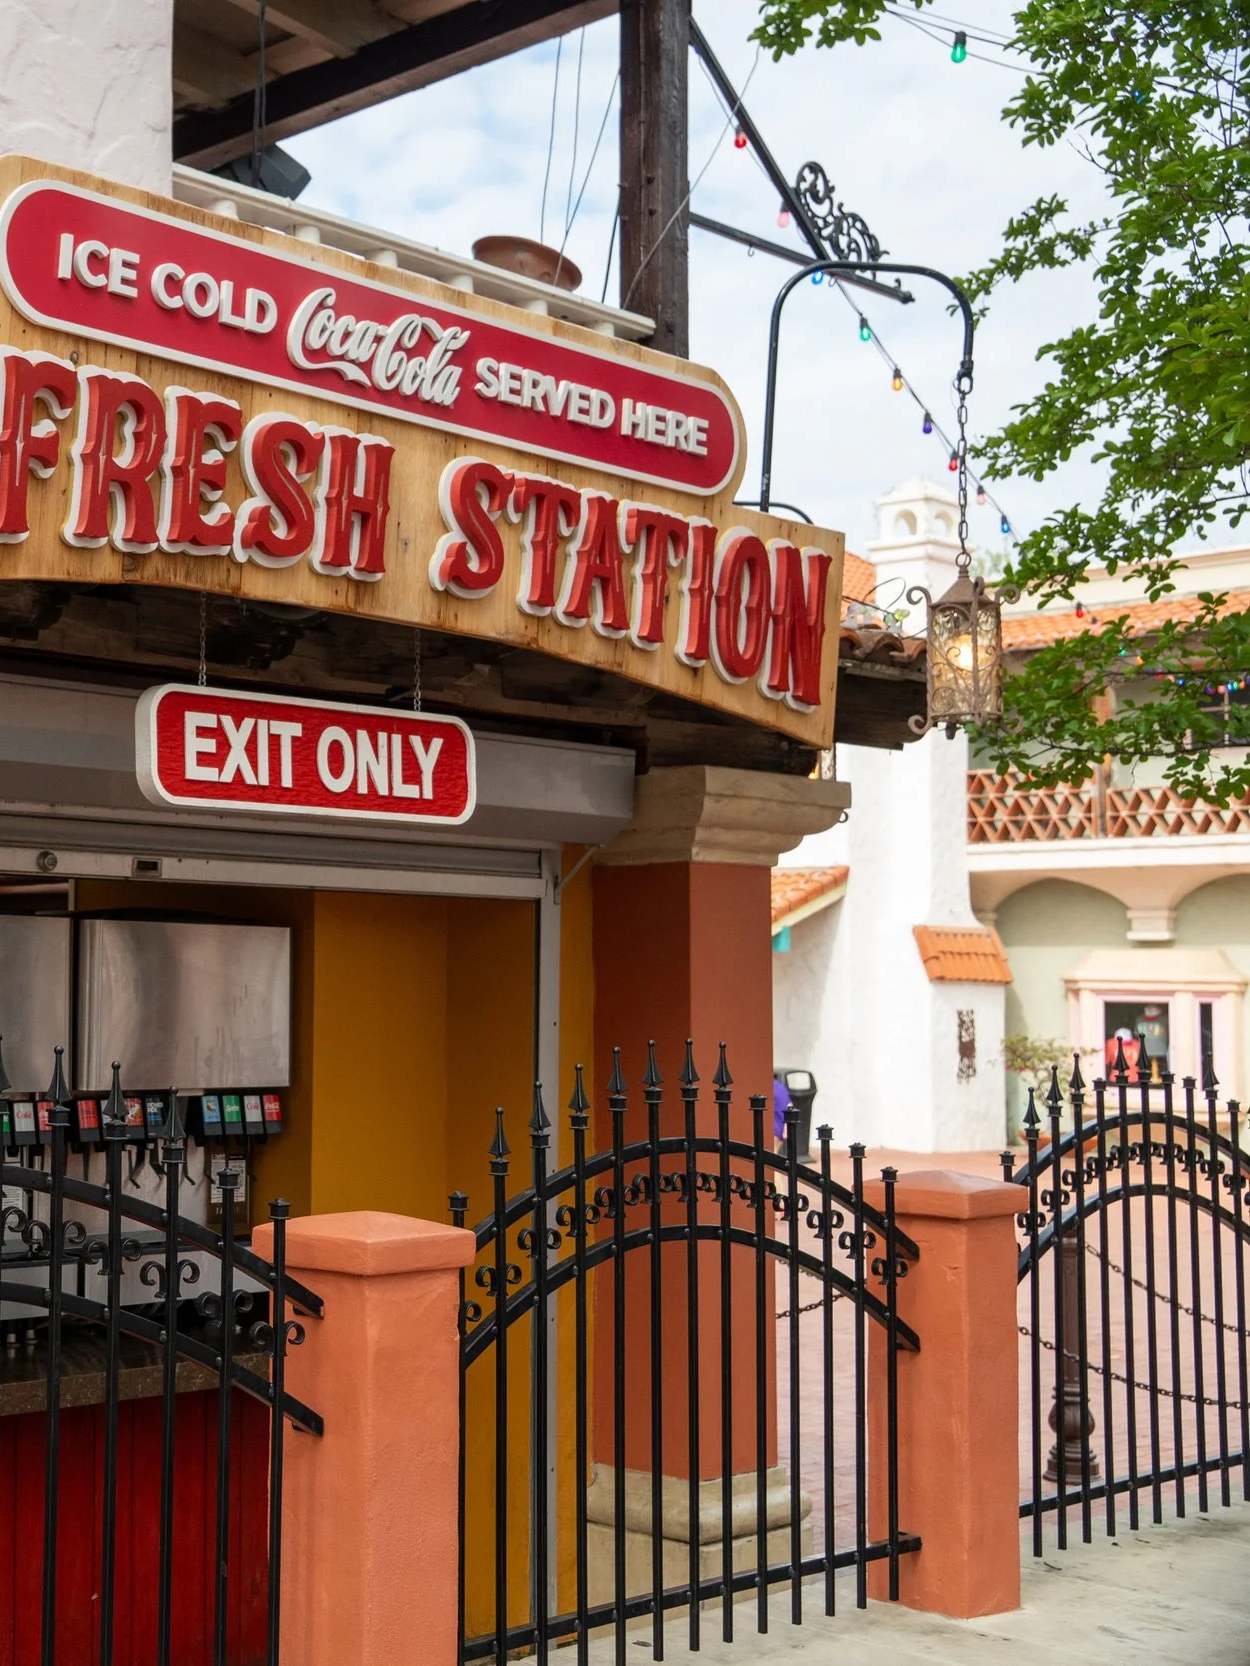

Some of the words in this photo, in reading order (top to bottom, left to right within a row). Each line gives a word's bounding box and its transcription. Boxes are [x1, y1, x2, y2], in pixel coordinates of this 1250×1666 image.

[57, 232, 141, 299] ICE
[151, 263, 278, 334] COLD
[286, 286, 471, 407] Coca-Cola
[475, 356, 616, 430] SERVED
[620, 397, 709, 457] HERE
[429, 456, 833, 714] STATION
[184, 711, 302, 788] EXIT
[316, 725, 444, 800] ONLY
